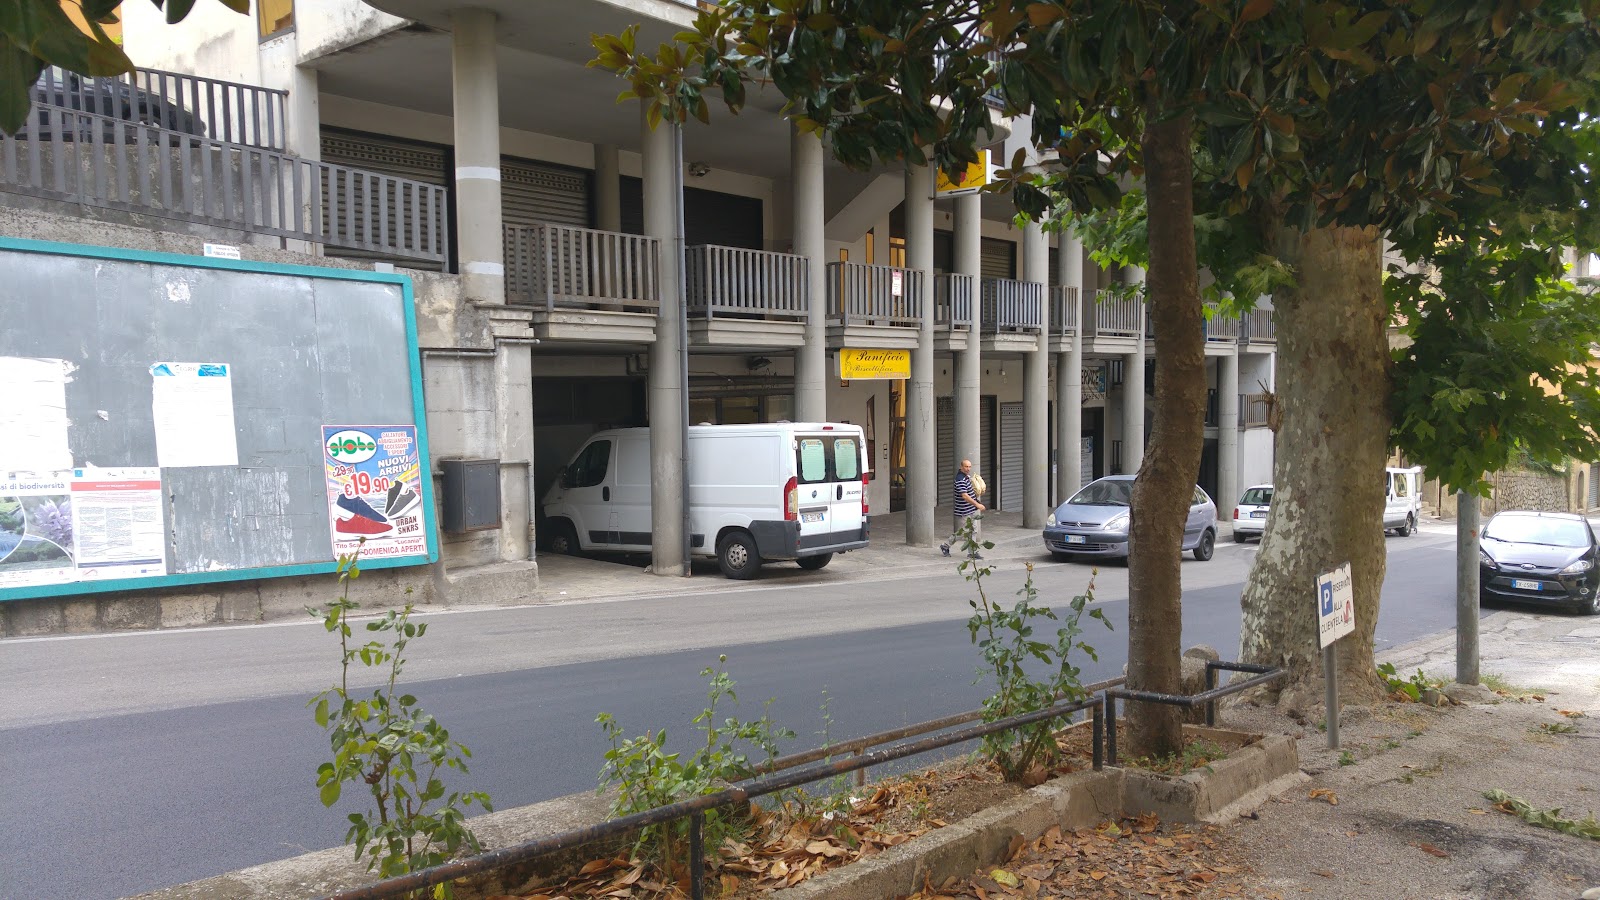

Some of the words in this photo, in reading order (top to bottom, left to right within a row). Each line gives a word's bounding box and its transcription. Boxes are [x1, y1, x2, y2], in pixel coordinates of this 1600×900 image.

[856, 350, 904, 364] Panificio
[330, 436, 376, 457] globo
[378, 455, 409, 468] NUOVI
[379, 463, 412, 476] ARRIVI
[9, 482, 17, 490] di
[19, 481, 65, 490] biodiversità
[395, 515, 417, 527] URBAN
[398, 524, 419, 535] SNKRS
[364, 547, 399, 556] DOMENICA
[400, 544, 425, 554] APERTI
[1323, 589, 1330, 609] P
[1333, 600, 1343, 613] ALLA
[1321, 615, 1343, 633] CLIENTELA
